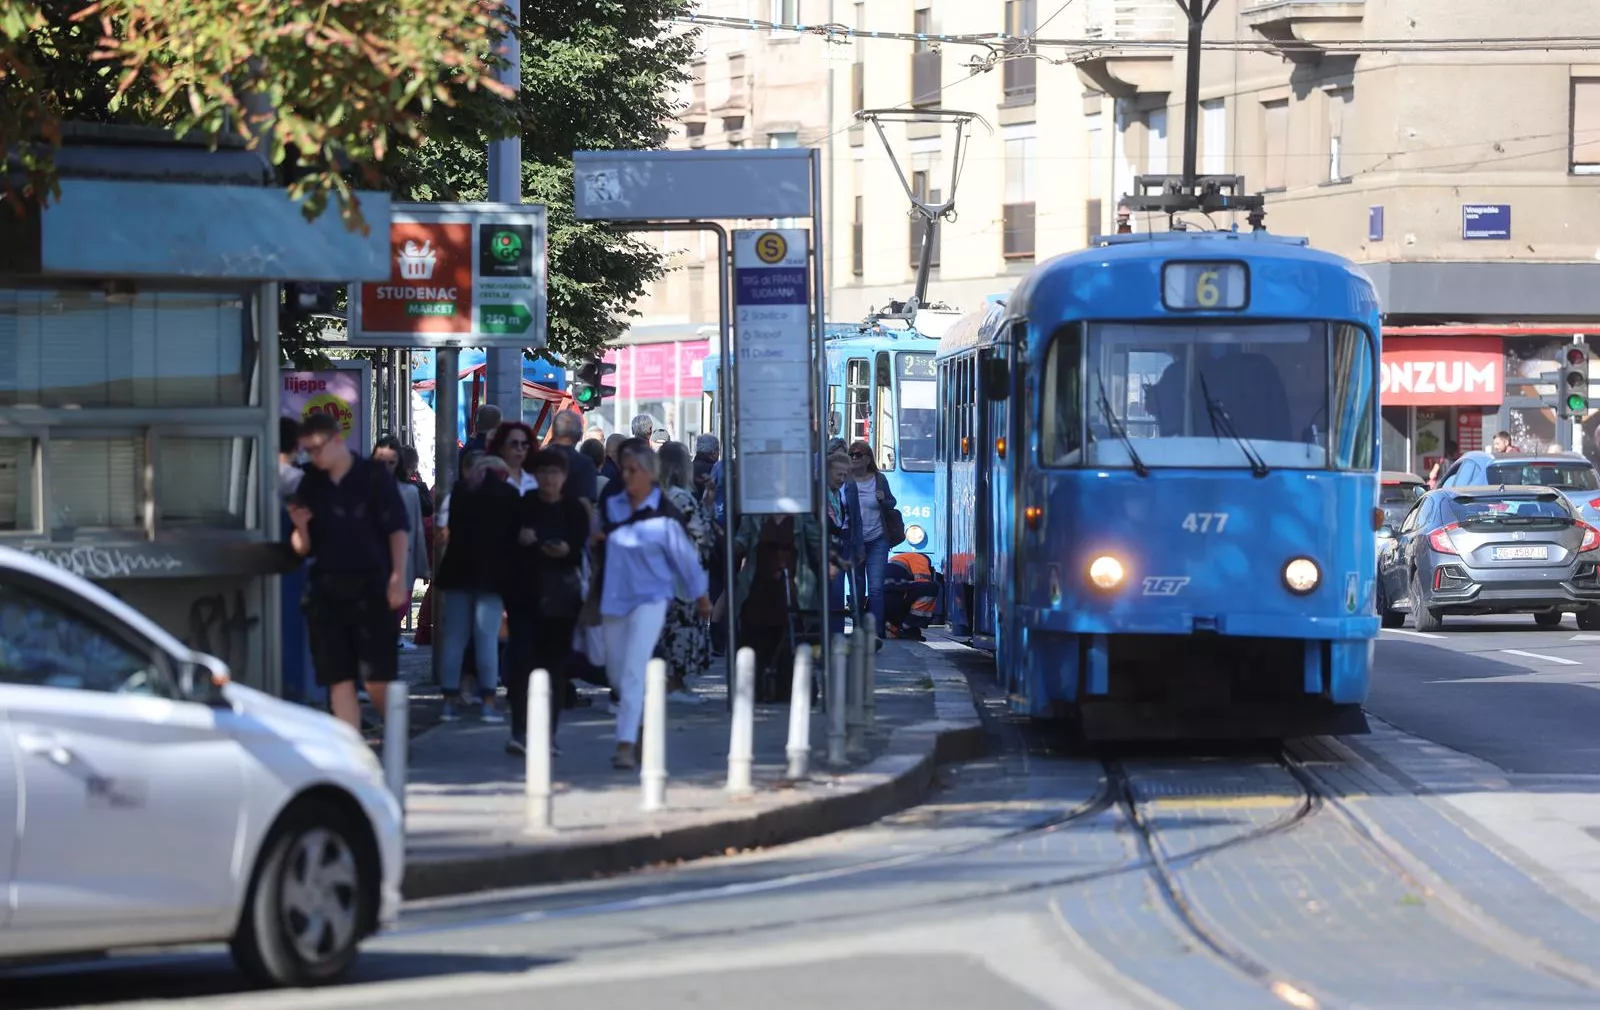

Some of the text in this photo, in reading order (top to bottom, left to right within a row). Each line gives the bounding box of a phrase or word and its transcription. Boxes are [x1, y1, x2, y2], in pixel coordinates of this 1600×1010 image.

[764, 239, 778, 257] S
[376, 286, 457, 300] STUDENAC
[1197, 271, 1219, 307] 6
[408, 303, 454, 314] MARKET
[486, 313, 520, 325] 250 m
[741, 309, 749, 322] 2
[742, 329, 751, 341] 6
[740, 348, 750, 359] 11
[284, 376, 326, 394] lijepe
[902, 505, 930, 517] 346
[1181, 512, 1229, 533] 477
[1142, 576, 1190, 596] ZET
